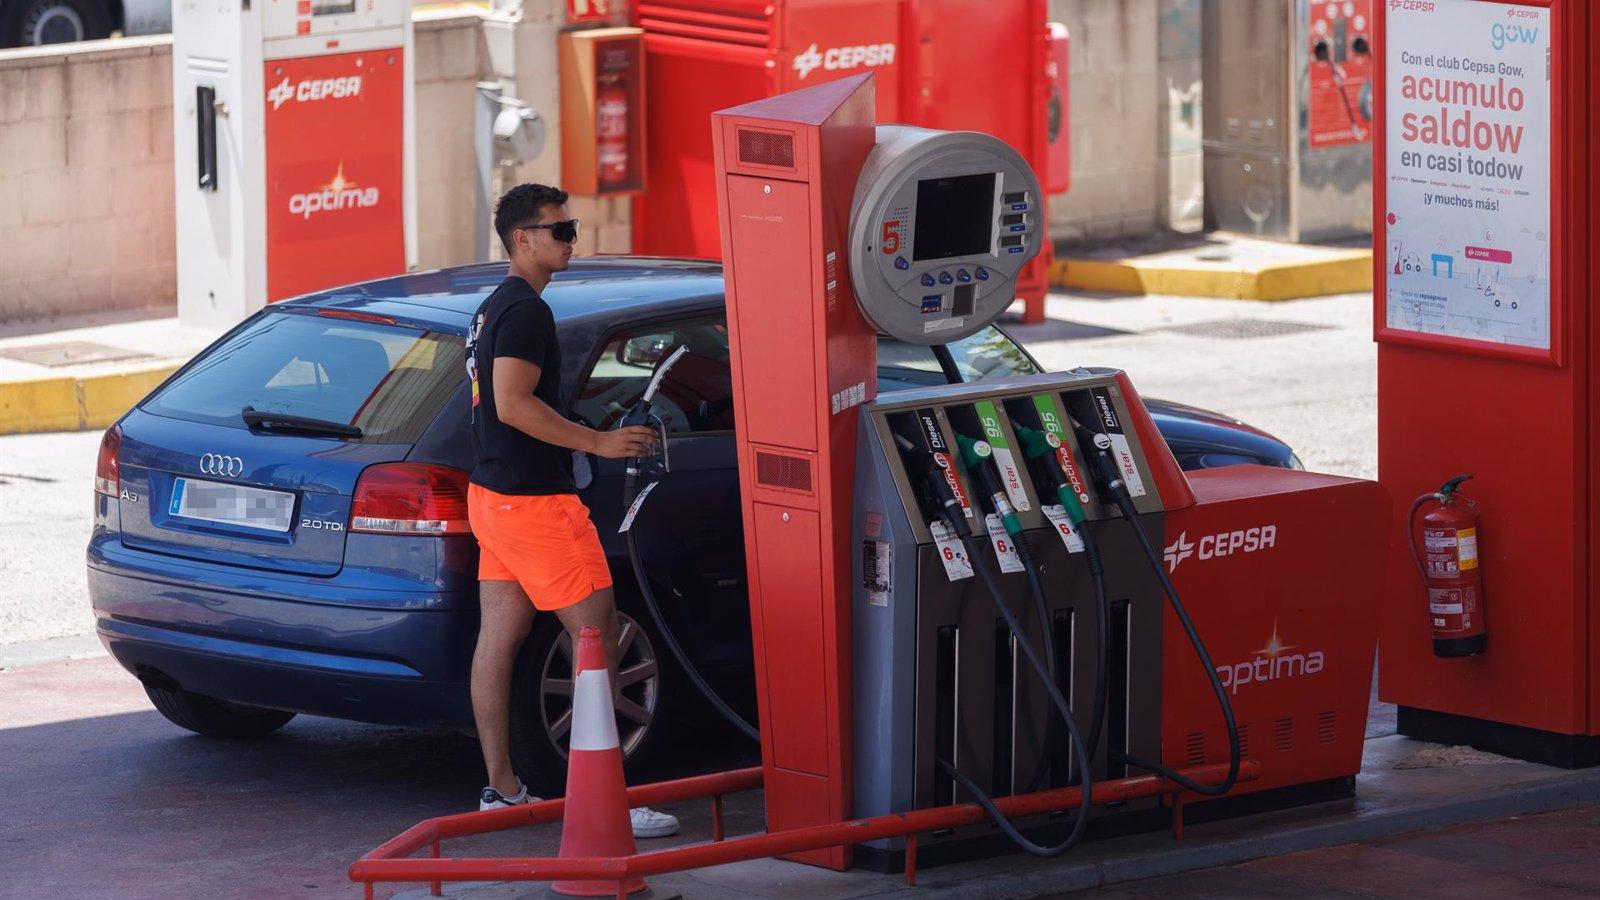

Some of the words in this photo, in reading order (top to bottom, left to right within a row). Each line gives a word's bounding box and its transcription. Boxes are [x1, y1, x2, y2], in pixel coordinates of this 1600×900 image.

[1403, 0, 1435, 12] CEPSA
[1516, 10, 1539, 20] CEPSA
[824, 43, 896, 70] CEPSA
[1402, 52, 1421, 66] Con
[1424, 54, 1434, 67] el
[1437, 56, 1460, 70] club
[1462, 58, 1495, 75] Cepsa
[1498, 63, 1524, 78] Gow,
[296, 75, 362, 102] CEPSA
[1402, 75, 1524, 112] acumulo
[1402, 107, 1524, 154] saldow
[1401, 151, 1421, 168] en
[1426, 153, 1462, 173] casi
[1467, 156, 1523, 180] todow
[289, 186, 379, 220] optima
[1435, 195, 1473, 208] muchos
[1475, 197, 1500, 212] más!
[882, 218, 900, 255] 5
[1042, 412, 1059, 432] 95
[1096, 395, 1115, 427] Diesel
[922, 416, 941, 448] Diesel
[983, 417, 1000, 438] 95
[1060, 447, 1082, 493] optima
[1121, 450, 1135, 475] star
[1005, 464, 1020, 489] star
[121, 490, 138, 502] A3
[1059, 523, 1071, 535] 6
[1198, 524, 1277, 560] CEPSA
[943, 546, 954, 561] 6
[996, 539, 1008, 554] 6
[1215, 651, 1324, 695] optima
